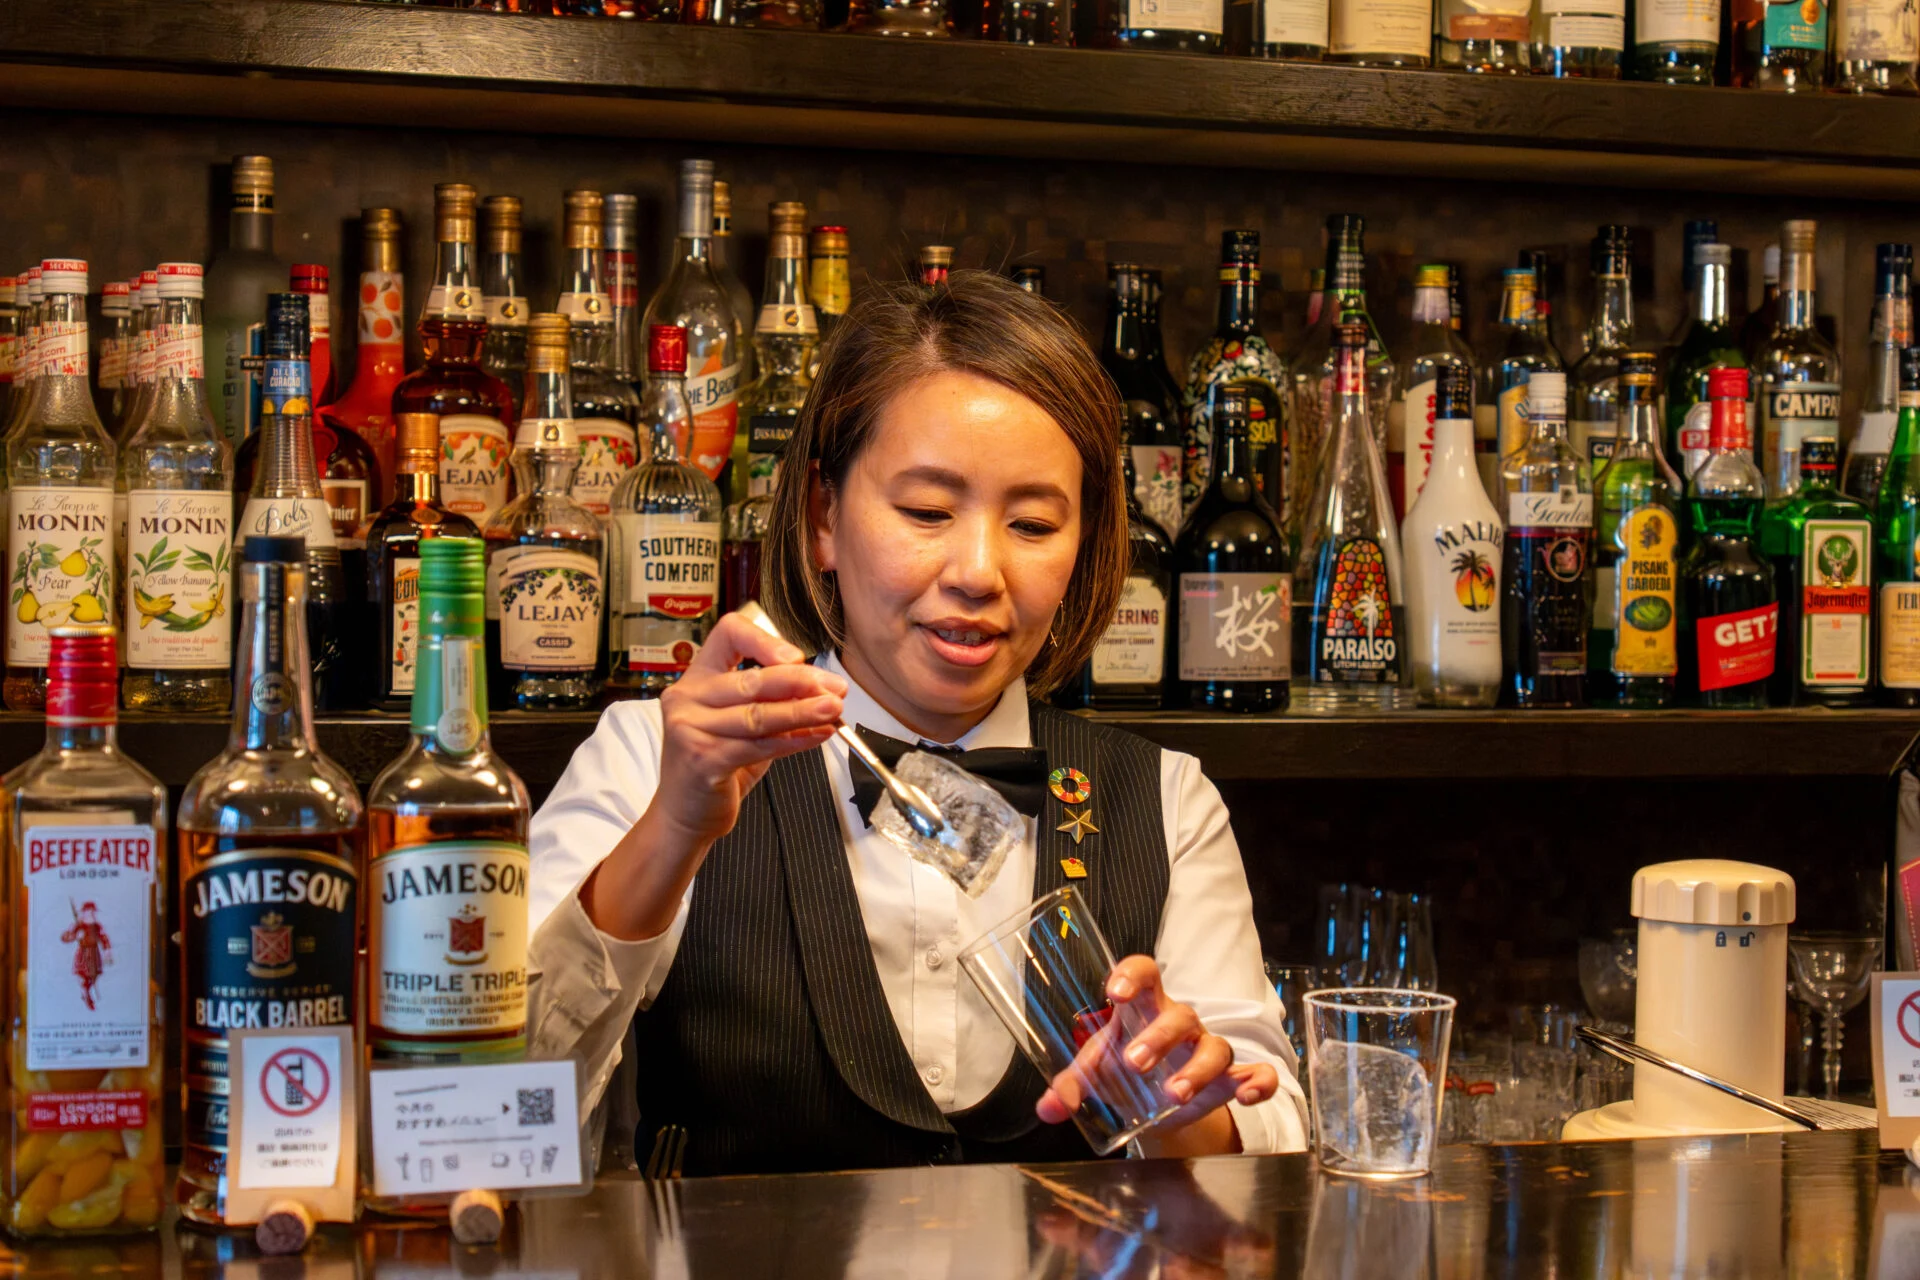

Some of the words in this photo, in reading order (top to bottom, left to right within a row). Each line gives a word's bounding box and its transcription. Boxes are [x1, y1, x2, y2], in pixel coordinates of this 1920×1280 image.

[574, 471, 620, 487] EJA
[17, 513, 106, 532] MONIN
[139, 516, 227, 534] MONIN
[255, 496, 308, 537] Bols
[1435, 521, 1502, 556] MALIB
[645, 562, 715, 582] COMFORT
[1632, 560, 1669, 575] PISANG
[37, 570, 72, 592] Pear
[147, 574, 178, 588] Yellow
[179, 571, 212, 586] Banana
[518, 603, 589, 621] LEJAY
[1714, 614, 1768, 647] GET
[1323, 637, 1396, 661] PARAISO
[29, 837, 151, 875] BEEFEATER
[60, 868, 120, 879] LONDON
[383, 862, 526, 904] JAMESON
[193, 868, 350, 918] JAMESON
[383, 970, 463, 992] TRIPLE
[471, 967, 526, 991] TRIPLE
[195, 997, 262, 1029] BLACK
[267, 995, 348, 1029] BARREL
[457, 1015, 500, 1026] WHISKEY
[59, 1101, 117, 1115] LONDON
[59, 1114, 87, 1126] DRY
[90, 1112, 117, 1125] GIN
